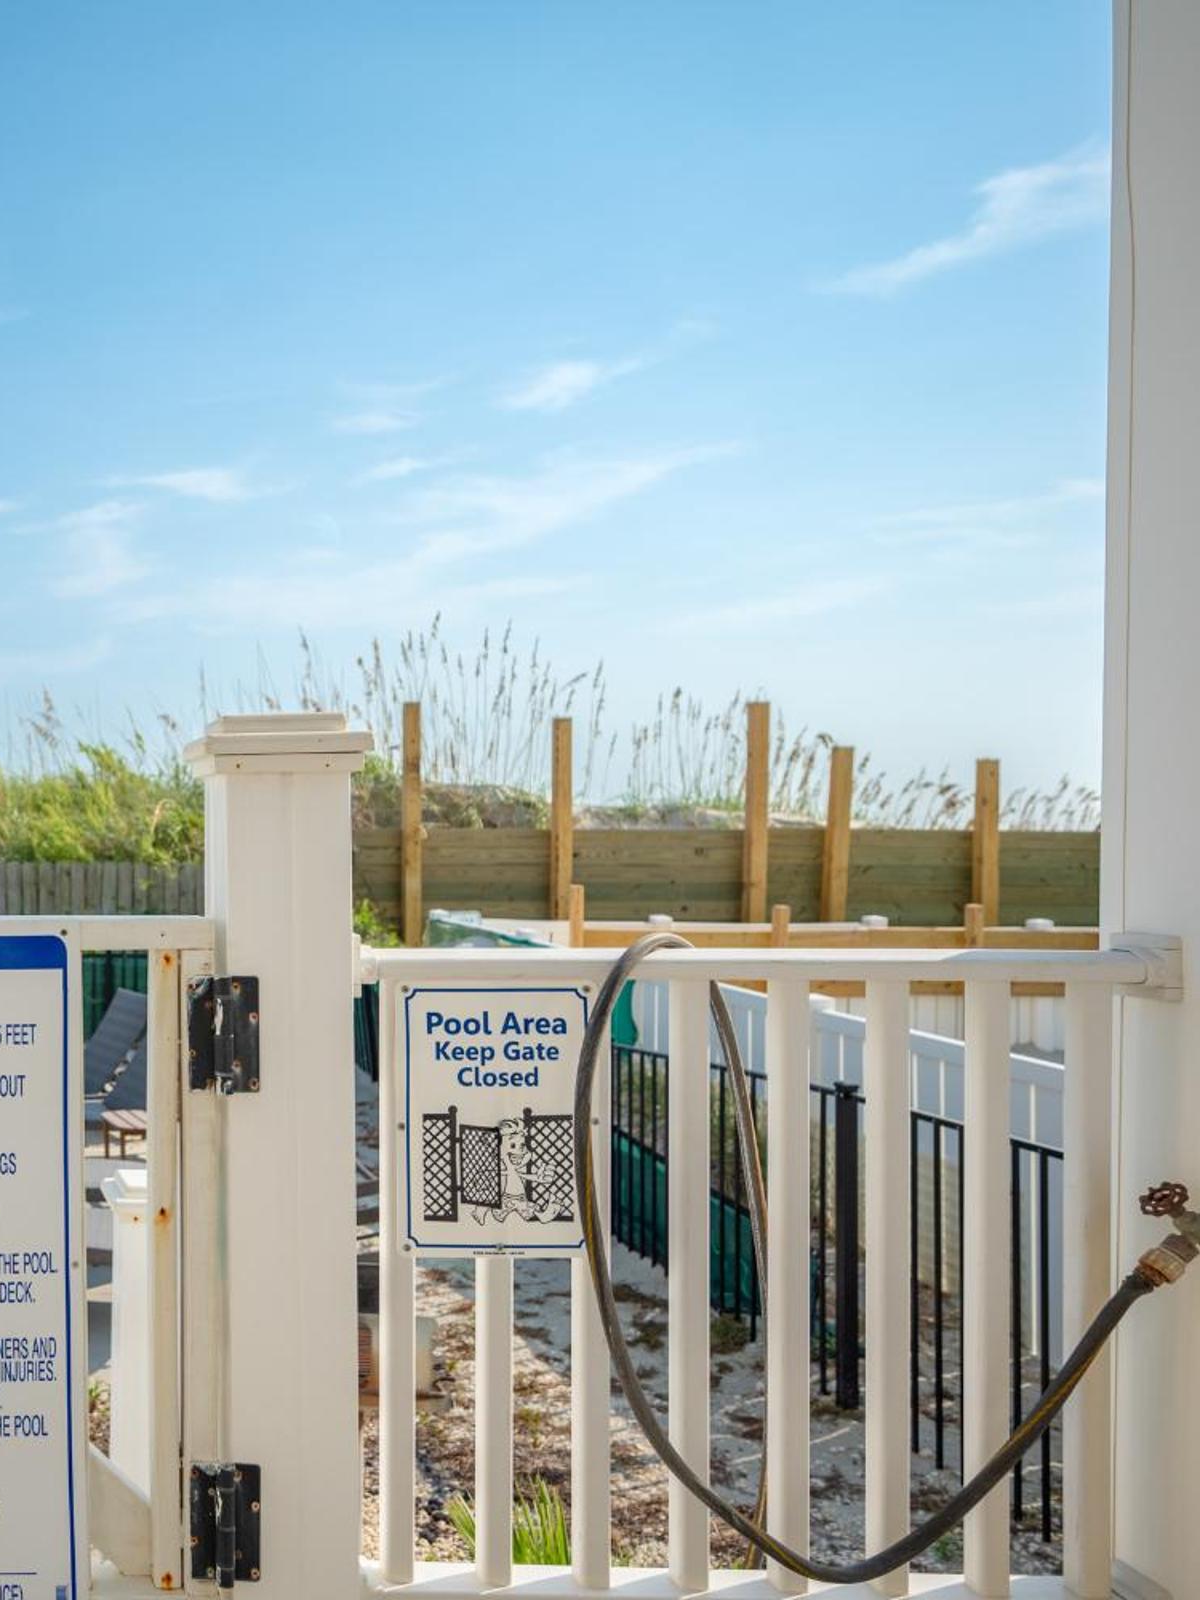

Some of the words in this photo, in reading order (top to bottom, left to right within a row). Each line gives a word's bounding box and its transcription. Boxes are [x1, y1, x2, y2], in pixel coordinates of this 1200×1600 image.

[5, 1023, 37, 1044] FEET
[426, 1011, 492, 1035] Pool
[501, 1011, 567, 1035] Area
[435, 1041, 495, 1065] Keep
[503, 1041, 560, 1061] Gate
[457, 1066, 539, 1087] Closed
[32, 1337, 57, 1358] AND
[0, 1361, 57, 1382] INJURIES.
[14, 1415, 48, 1436] POOL
